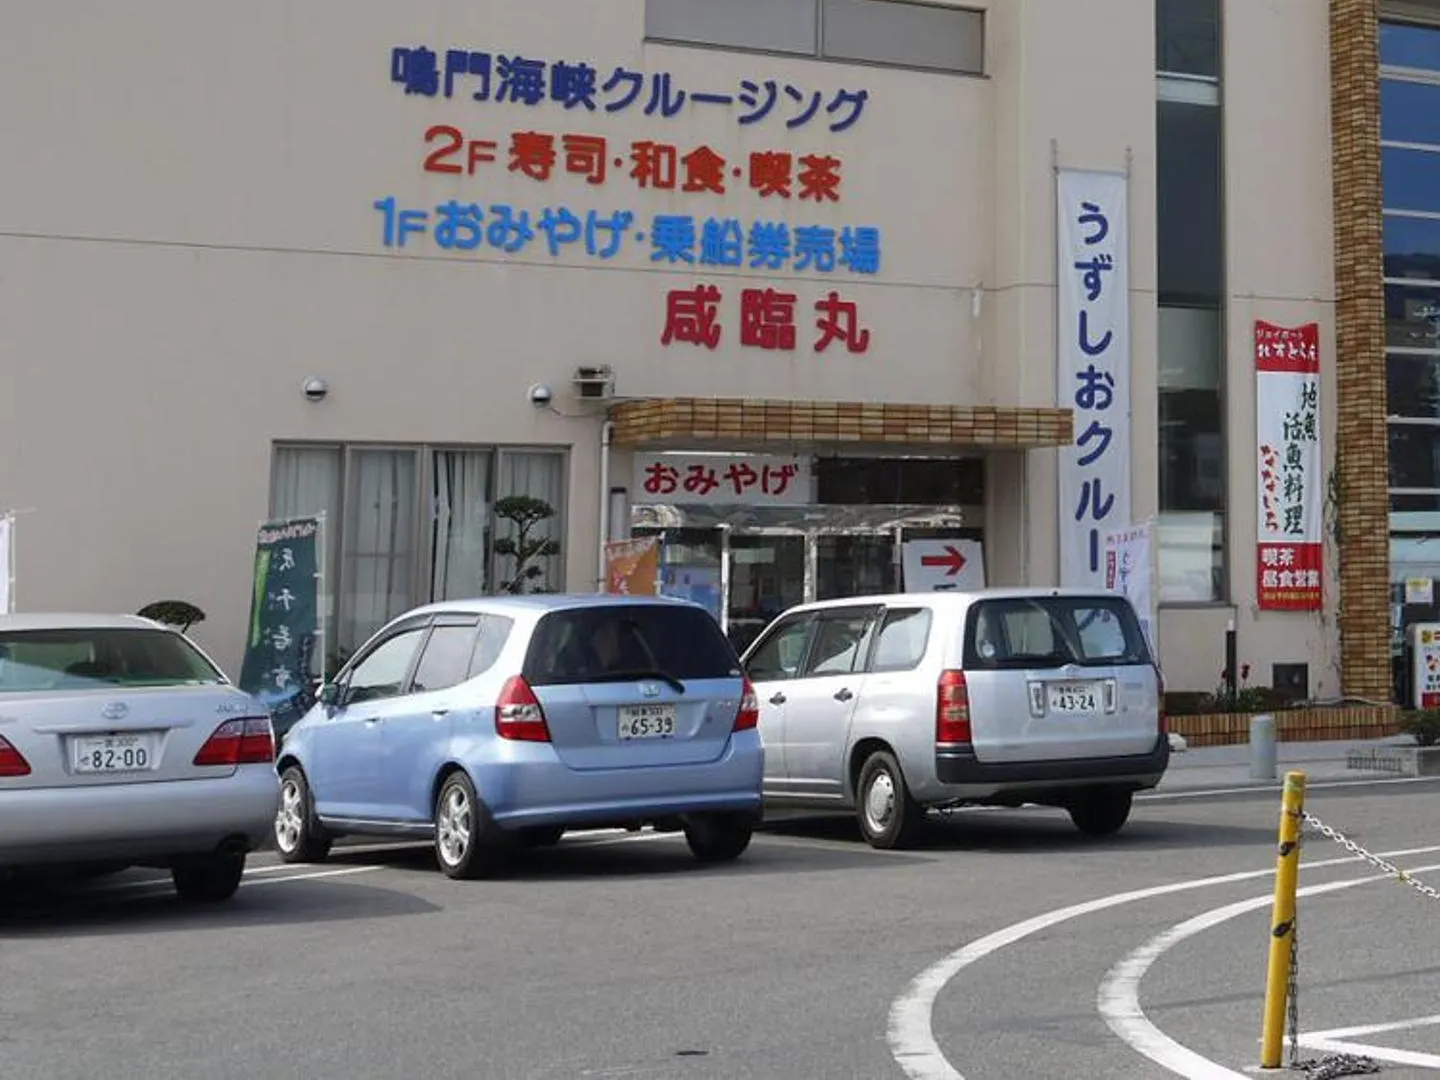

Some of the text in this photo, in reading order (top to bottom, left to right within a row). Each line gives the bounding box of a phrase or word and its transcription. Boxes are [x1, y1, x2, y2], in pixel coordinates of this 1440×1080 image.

[391, 46, 868, 132] 鳴門海峡クルージング
[661, 285, 869, 353] 咸臨丸
[644, 461, 799, 495] おみやげ
[631, 717, 673, 735] 65-39
[92, 749, 147, 768] 82-00
